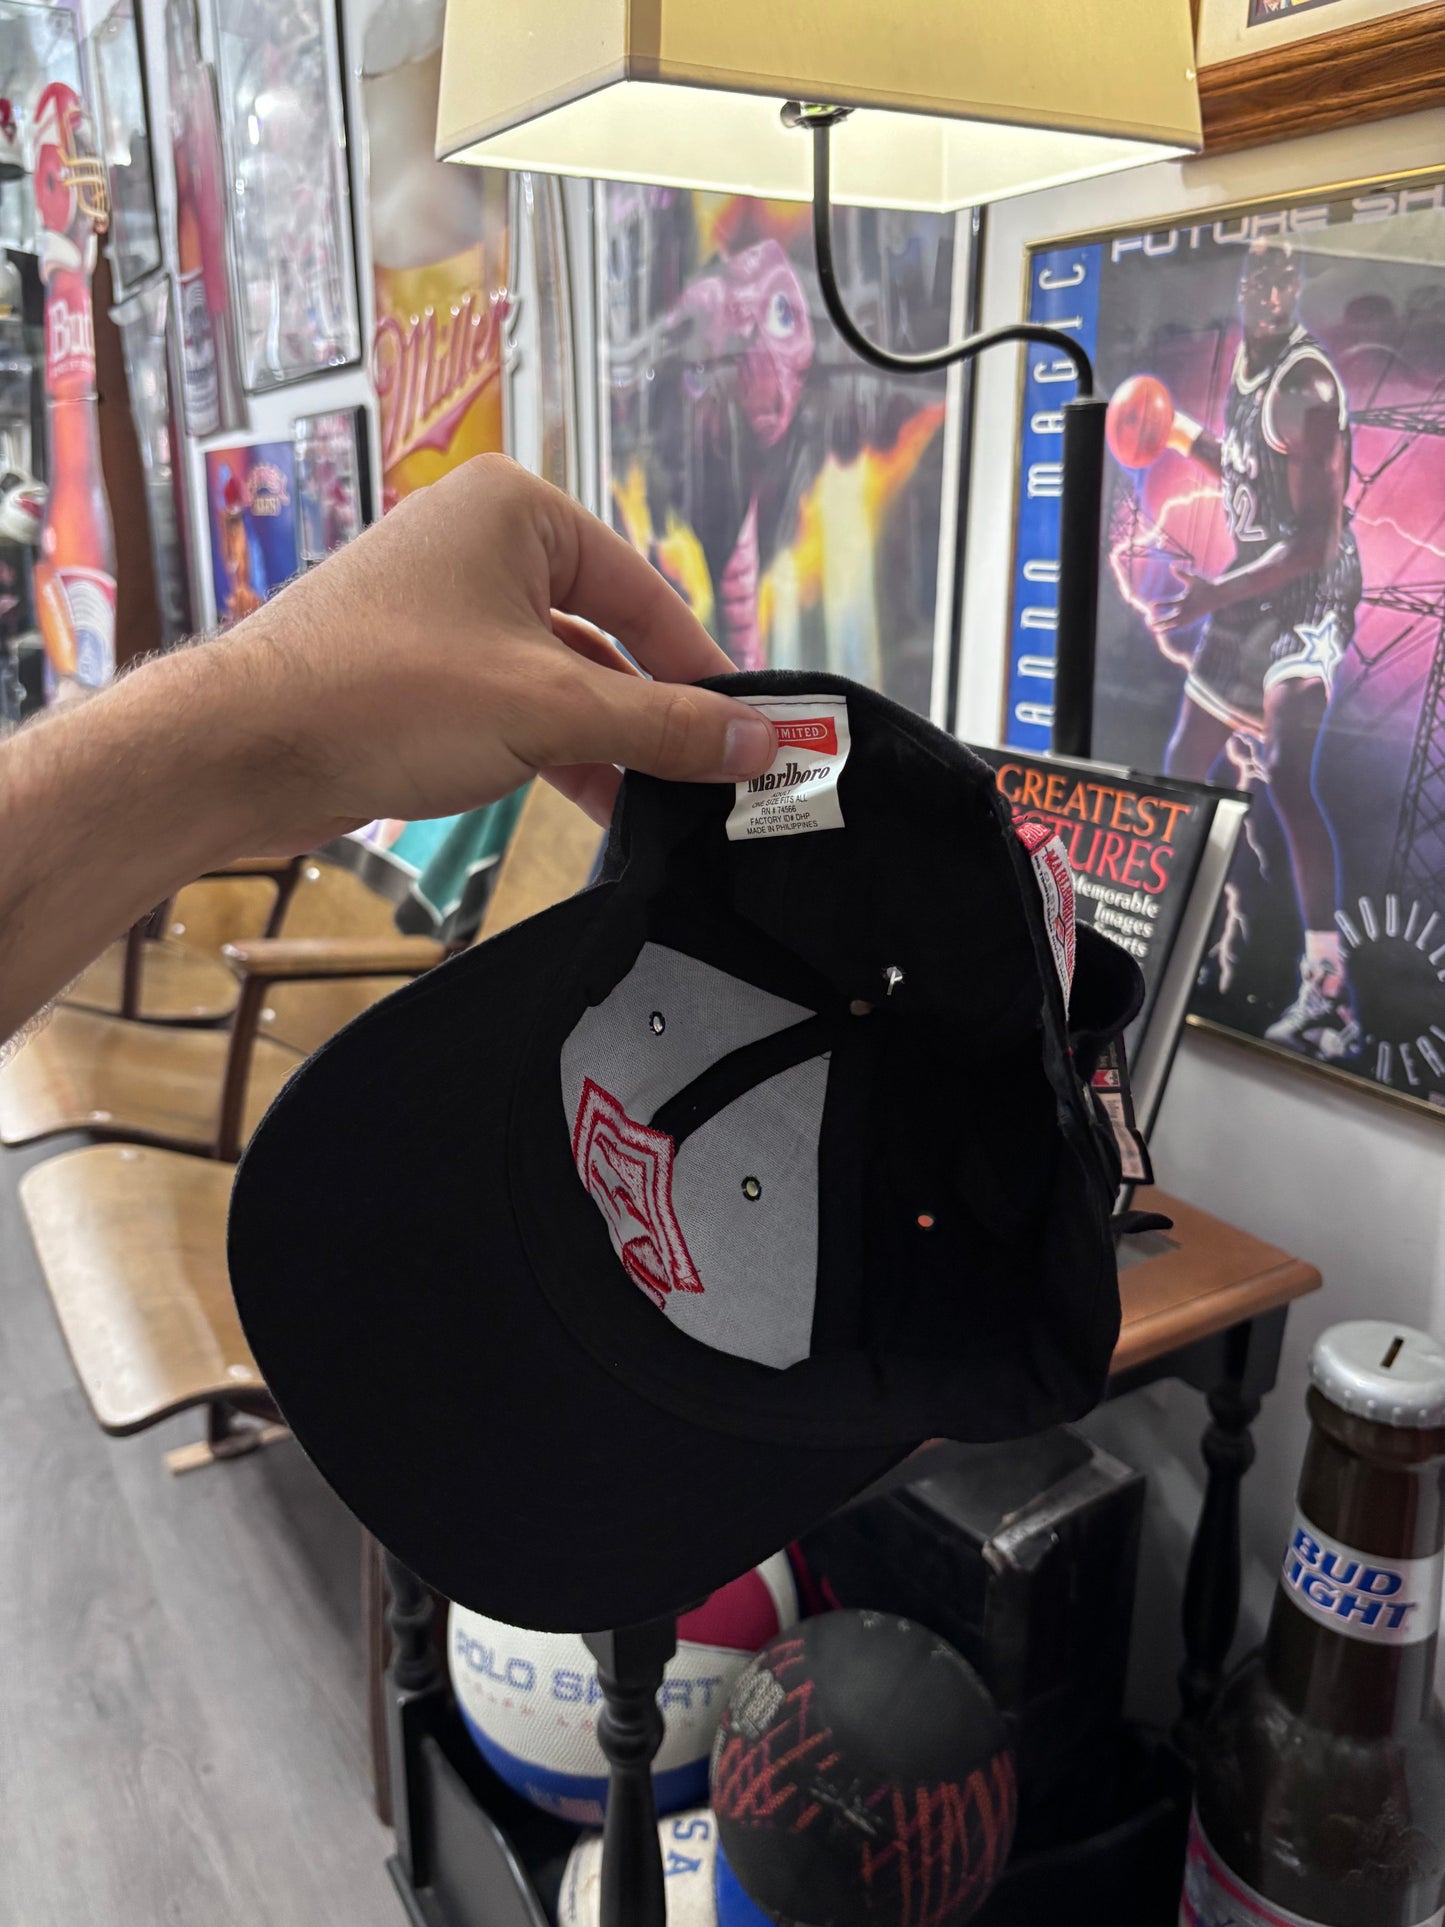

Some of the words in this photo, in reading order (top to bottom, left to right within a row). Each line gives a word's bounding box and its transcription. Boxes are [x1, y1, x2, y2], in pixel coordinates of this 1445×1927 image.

[1110, 204, 1330, 263] FUTURE
[747, 762, 831, 793] Marlboro
[751, 800, 764, 809] ONE
[765, 797, 780, 806] SIZE
[780, 796, 794, 804] FITS
[795, 793, 808, 803] ALL
[761, 807, 771, 815] RN
[996, 762, 1192, 843] GREATEST
[746, 826, 768, 835] MADE
[767, 825, 775, 833] IN
[776, 820, 819, 832] PHILIPPINES
[750, 815, 782, 826] FACTORY
[1073, 872, 1160, 919] Memorable
[1093, 901, 1155, 938] Images
[1292, 1527, 1404, 1597] BUD
[455, 1627, 538, 1693] POLO
